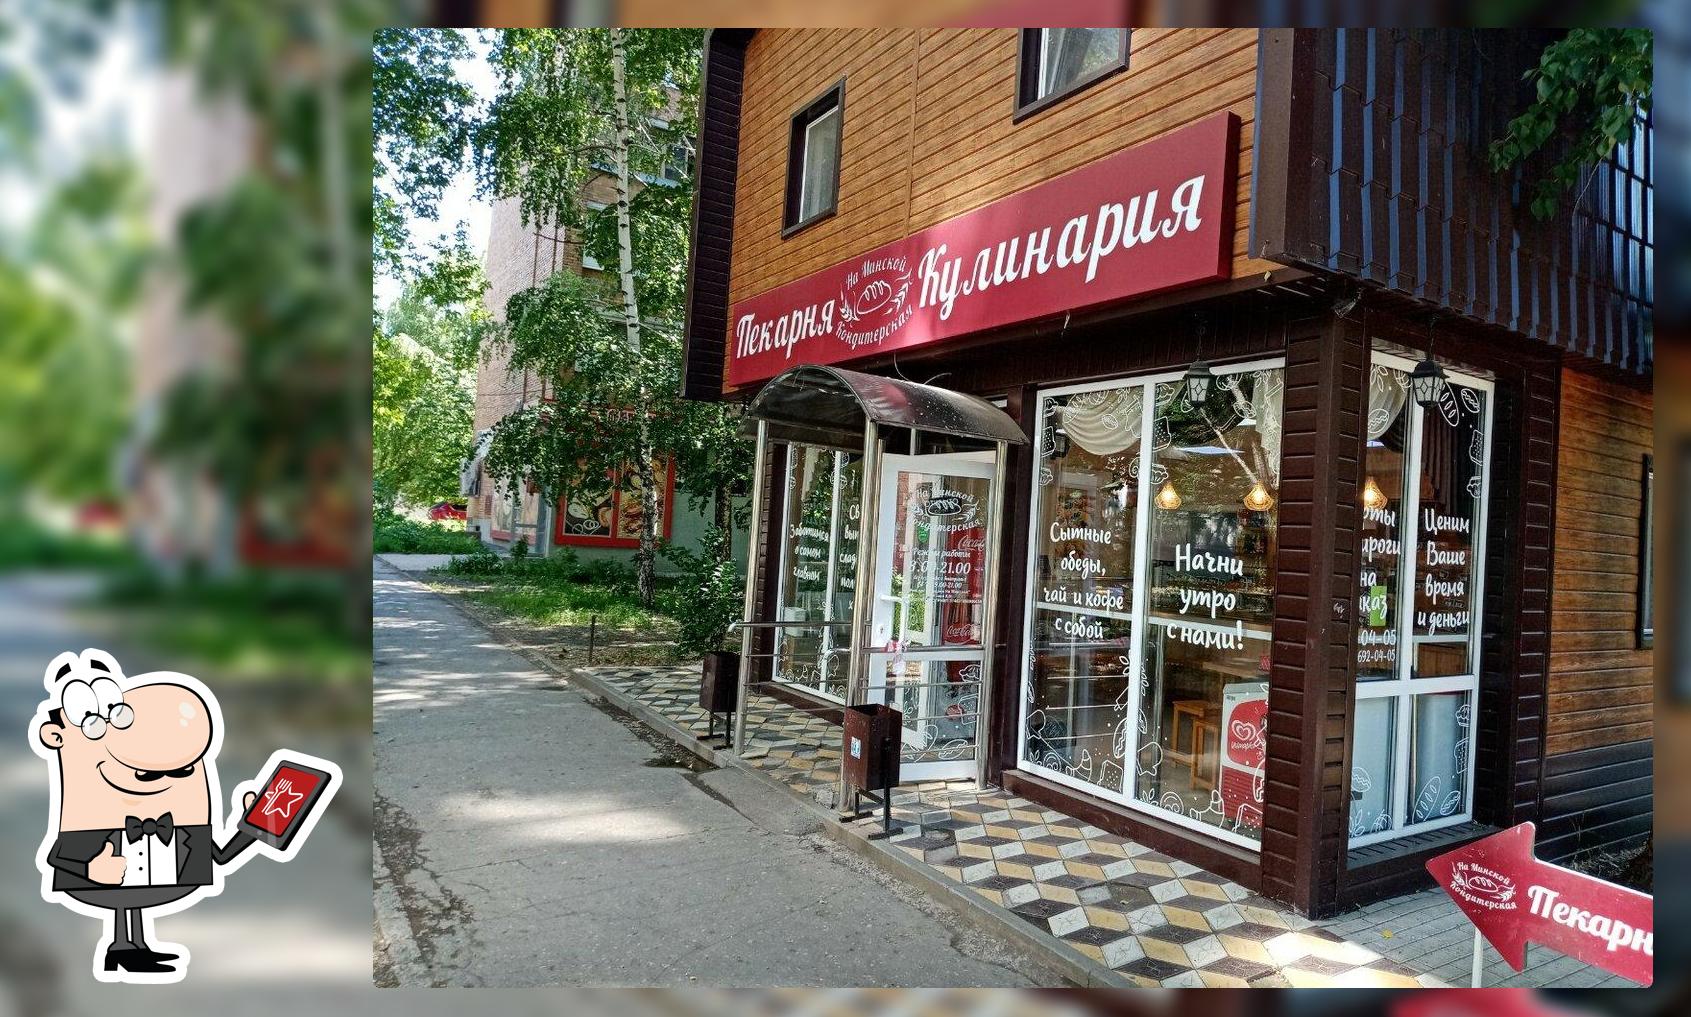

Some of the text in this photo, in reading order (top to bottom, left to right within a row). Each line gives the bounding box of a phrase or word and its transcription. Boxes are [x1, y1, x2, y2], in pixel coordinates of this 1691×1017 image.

[918, 174, 1206, 320] Кулинария
[846, 256, 907, 290] На Минской
[736, 299, 835, 360] Пекарня
[836, 304, 913, 350] Кондитерская
[934, 489, 975, 502] инской
[789, 522, 829, 543] Заботимся
[1050, 522, 1112, 545] Сытные
[1424, 508, 1470, 535] Ценим
[1060, 550, 1106, 580] обеды,
[1174, 543, 1244, 576] Начни
[1426, 540, 1466, 566] Ваше
[1360, 572, 1377, 587] на
[1425, 573, 1465, 605] время
[1043, 587, 1124, 616] чай и кофе
[1179, 589, 1237, 618] утро
[1055, 616, 1104, 640] с собой
[1166, 620, 1244, 649] с нами!
[1417, 610, 1470, 636] и деньги
[1457, 861, 1511, 885] На Минской
[1450, 882, 1517, 909] Кондитерская
